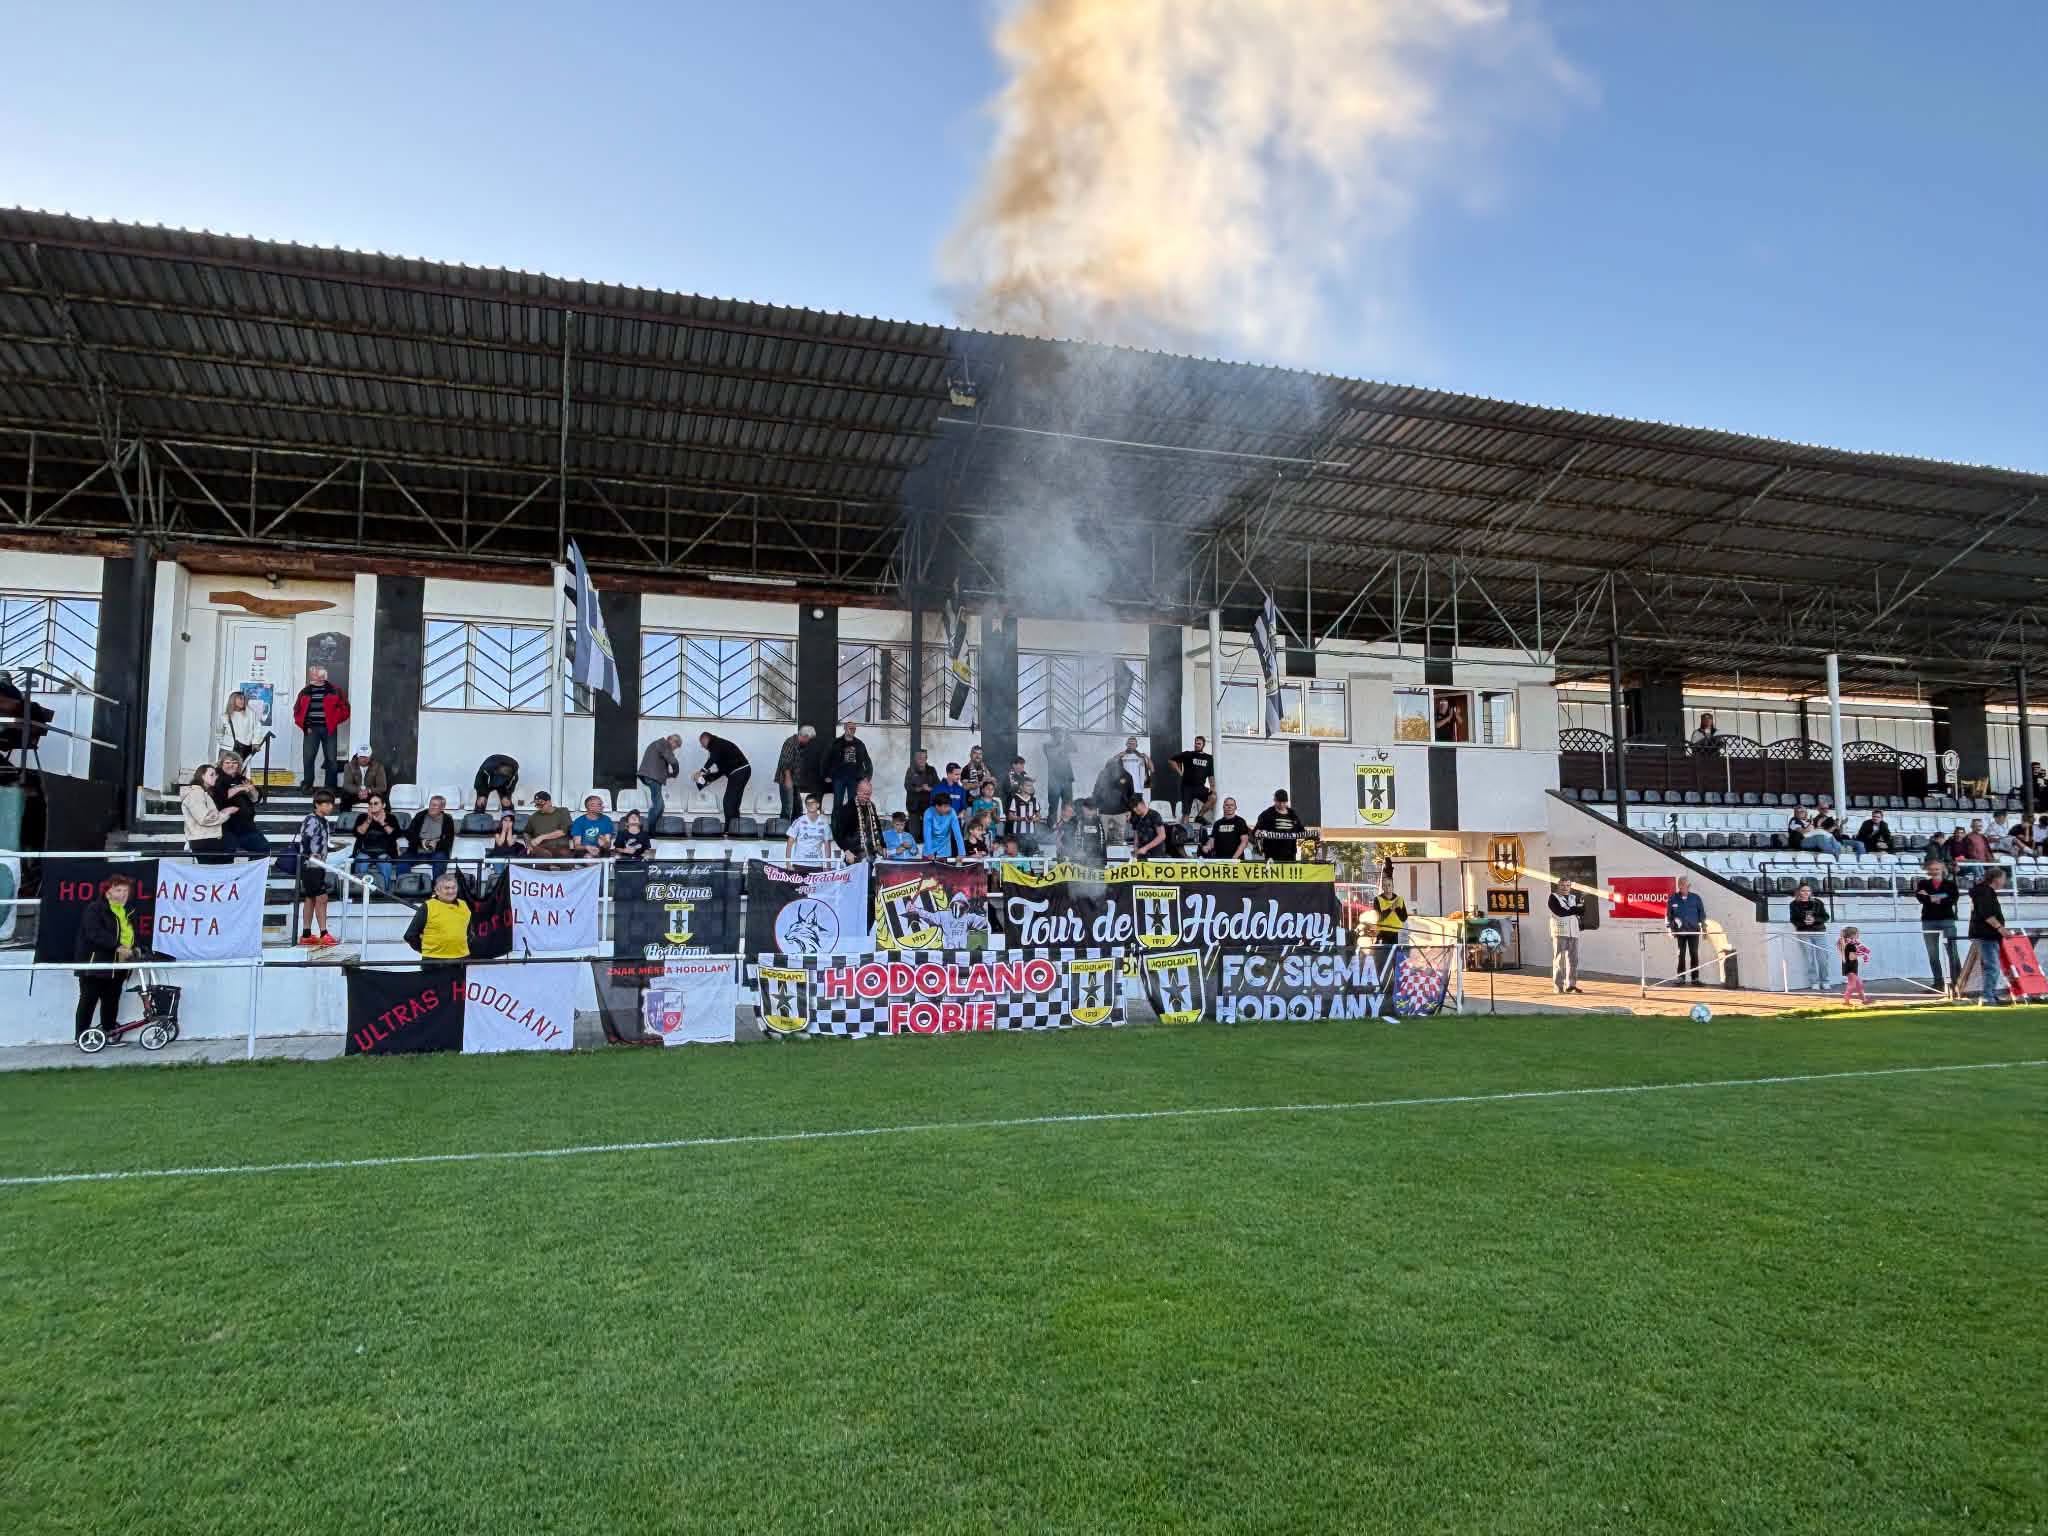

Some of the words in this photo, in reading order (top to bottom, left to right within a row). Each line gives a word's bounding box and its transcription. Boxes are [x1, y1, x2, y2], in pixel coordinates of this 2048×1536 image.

[1154, 866, 1175, 878] PO
[1180, 863, 1239, 879] PROHŘE
[1243, 863, 1284, 879] VĚRNÍ
[1289, 866, 1303, 880] !!!
[511, 879, 565, 899] SIGMA
[647, 883, 666, 901] FC
[667, 883, 713, 902] Sigma
[1138, 889, 1174, 898] HODOLANY
[1007, 896, 1085, 946] Tour
[1092, 900, 1133, 943] de
[1182, 893, 1334, 949] Hodolany
[676, 963, 730, 975] HODOLANY
[825, 959, 1056, 1000] HODOLANO
[1222, 955, 1267, 987] FC
[353, 989, 440, 1052] ULTRAS
[452, 981, 563, 1043] HODOLANY
[889, 1001, 997, 1034] FOBIE
[1215, 993, 1385, 1024] HODOLANY
